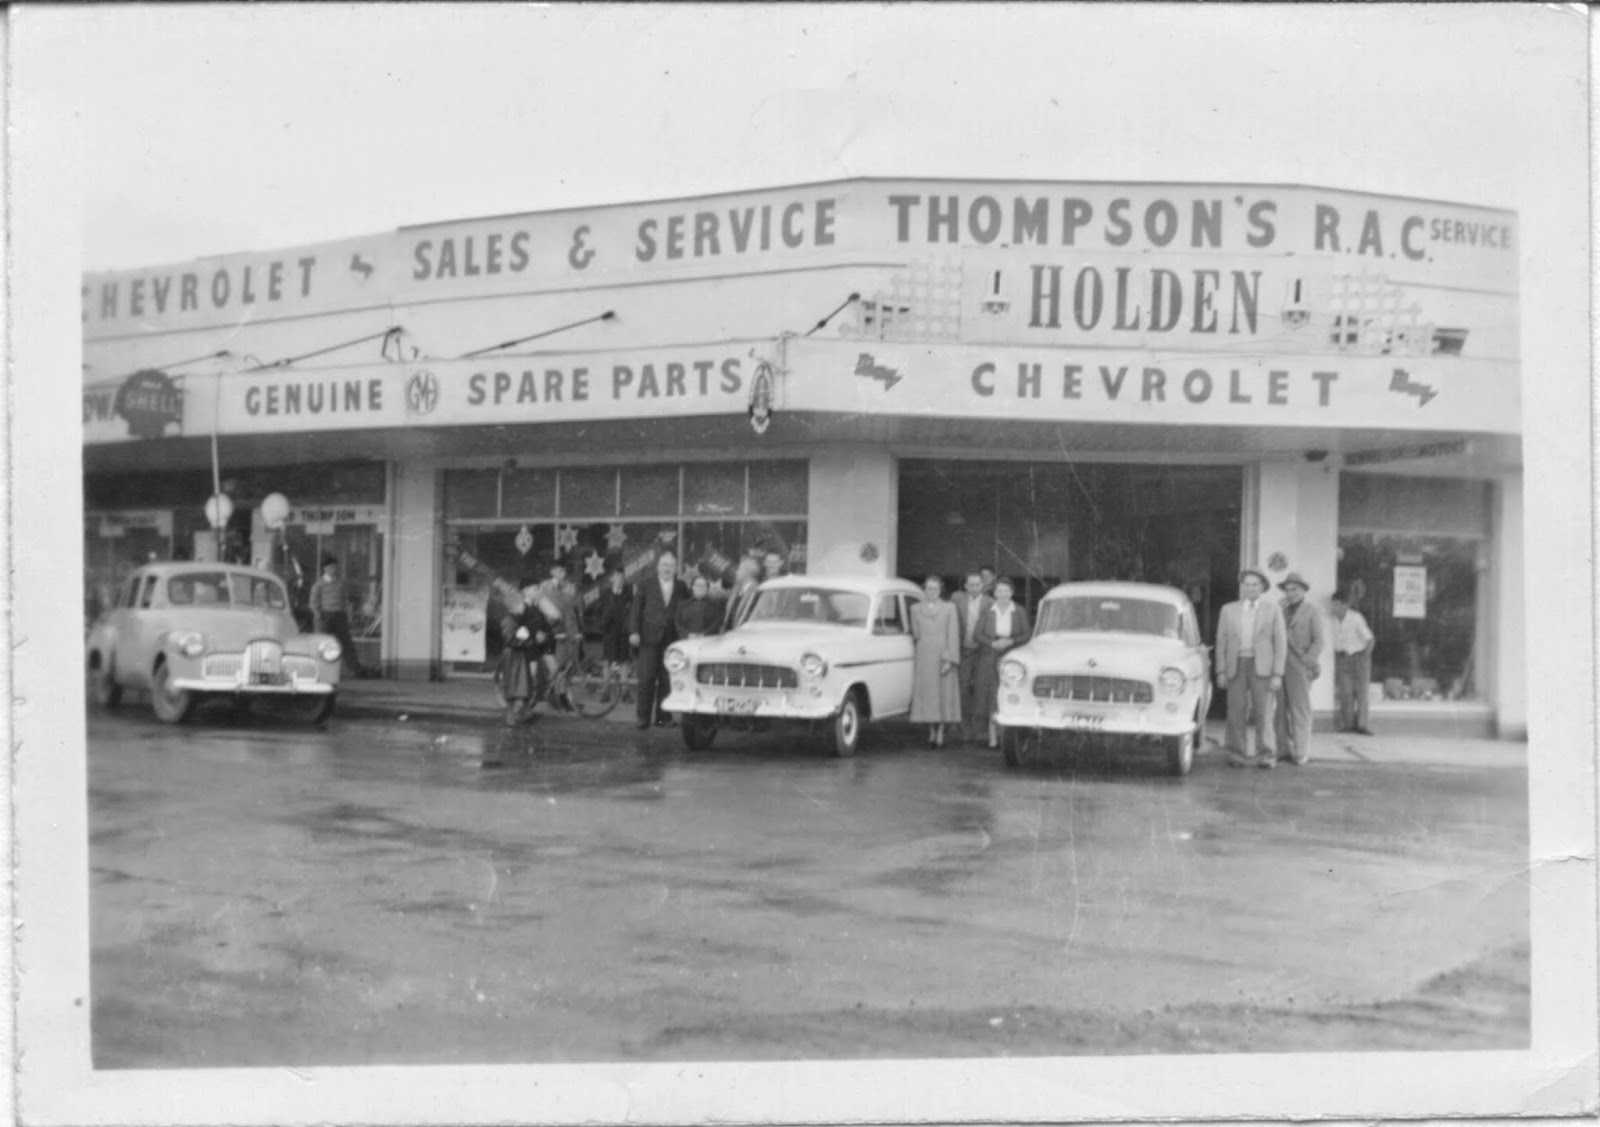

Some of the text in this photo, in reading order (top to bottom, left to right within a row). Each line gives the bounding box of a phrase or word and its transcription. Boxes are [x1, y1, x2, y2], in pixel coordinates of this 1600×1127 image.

[887, 193, 1277, 249] THOMPSON'S
[1430, 217, 1511, 249] SERVICE
[83, 199, 836, 322] HEVROLET SALES & SERVICE
[1027, 264, 1262, 334] HOLDEN
[244, 379, 383, 416] GENUINE
[467, 368, 590, 406] SPARE
[612, 358, 742, 399] PARTS
[971, 362, 1339, 406] CHEVROLET
